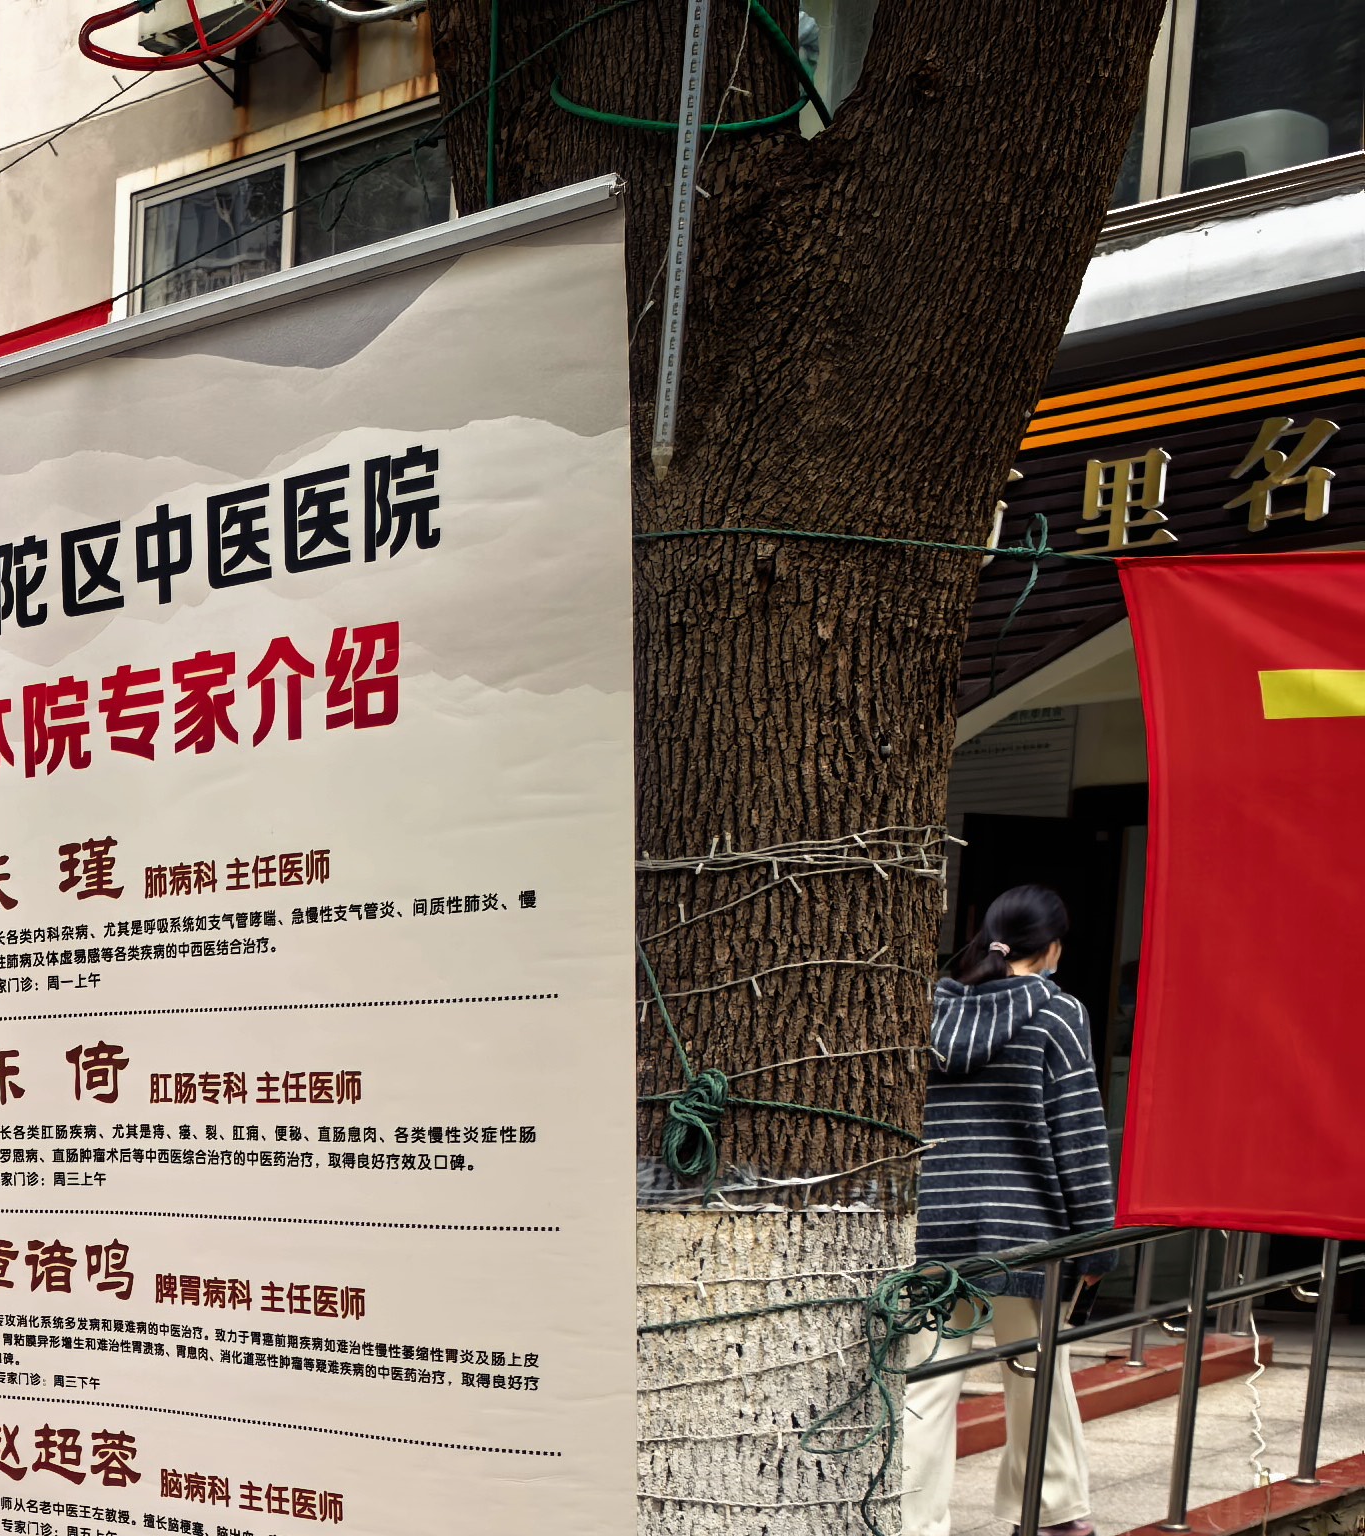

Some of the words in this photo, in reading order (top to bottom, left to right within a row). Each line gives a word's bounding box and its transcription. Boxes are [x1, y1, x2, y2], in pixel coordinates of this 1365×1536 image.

[58, 836, 124, 902] 瑾
[144, 860, 218, 899] 肺病科
[225, 849, 331, 893] 主任医师
[149, 1071, 248, 1105] 肛肠专科
[256, 1069, 362, 1106] 主任医师
[155, 1272, 253, 1313] 脾胃病科
[260, 1280, 366, 1322] 主任医师
[161, 1468, 232, 1508] 脑病科
[239, 1480, 344, 1524] 主任医师
